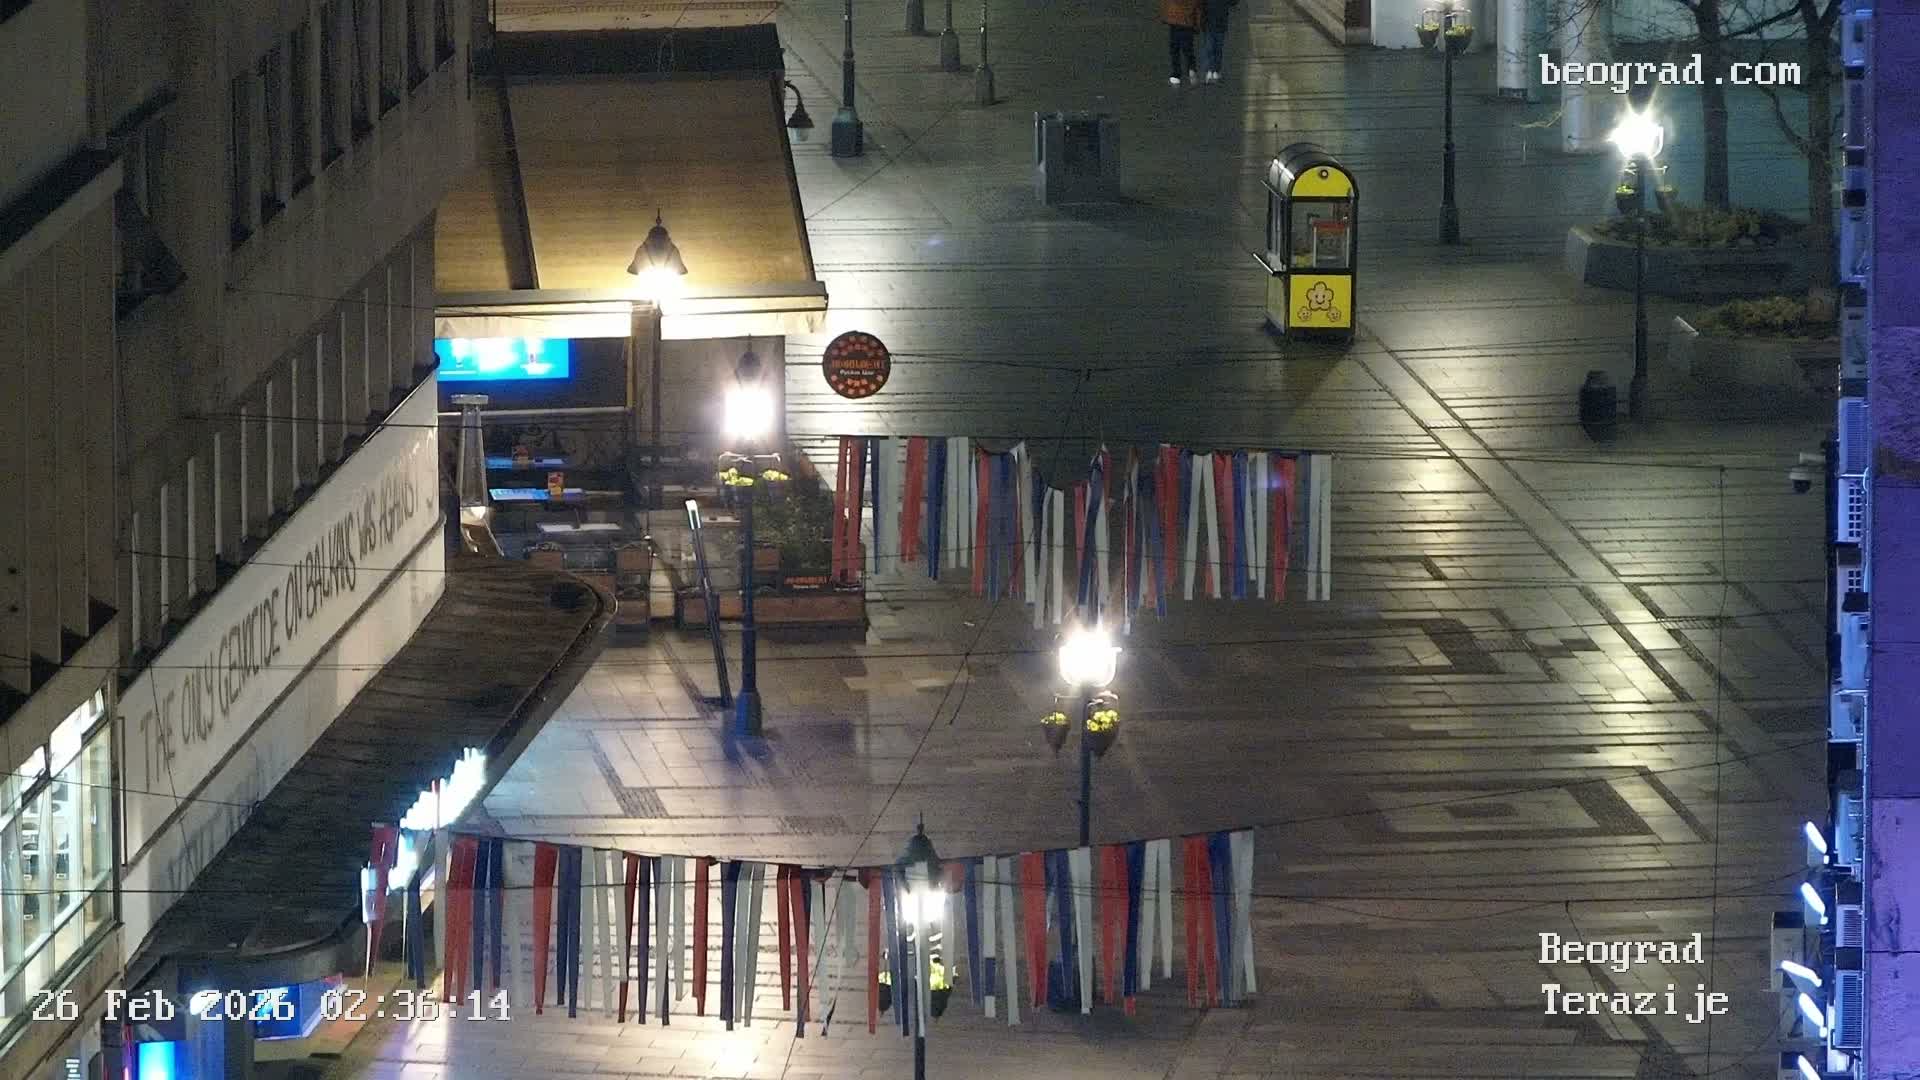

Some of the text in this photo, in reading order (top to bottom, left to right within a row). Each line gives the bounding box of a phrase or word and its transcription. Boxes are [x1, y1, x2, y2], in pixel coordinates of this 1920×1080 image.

[140, 689, 175, 793] THE
[181, 651, 214, 744] ONLY
[218, 587, 281, 718] GENOCIDE
[285, 559, 302, 640] ON
[306, 511, 356, 619] BALKANS
[357, 488, 376, 560] WAS
